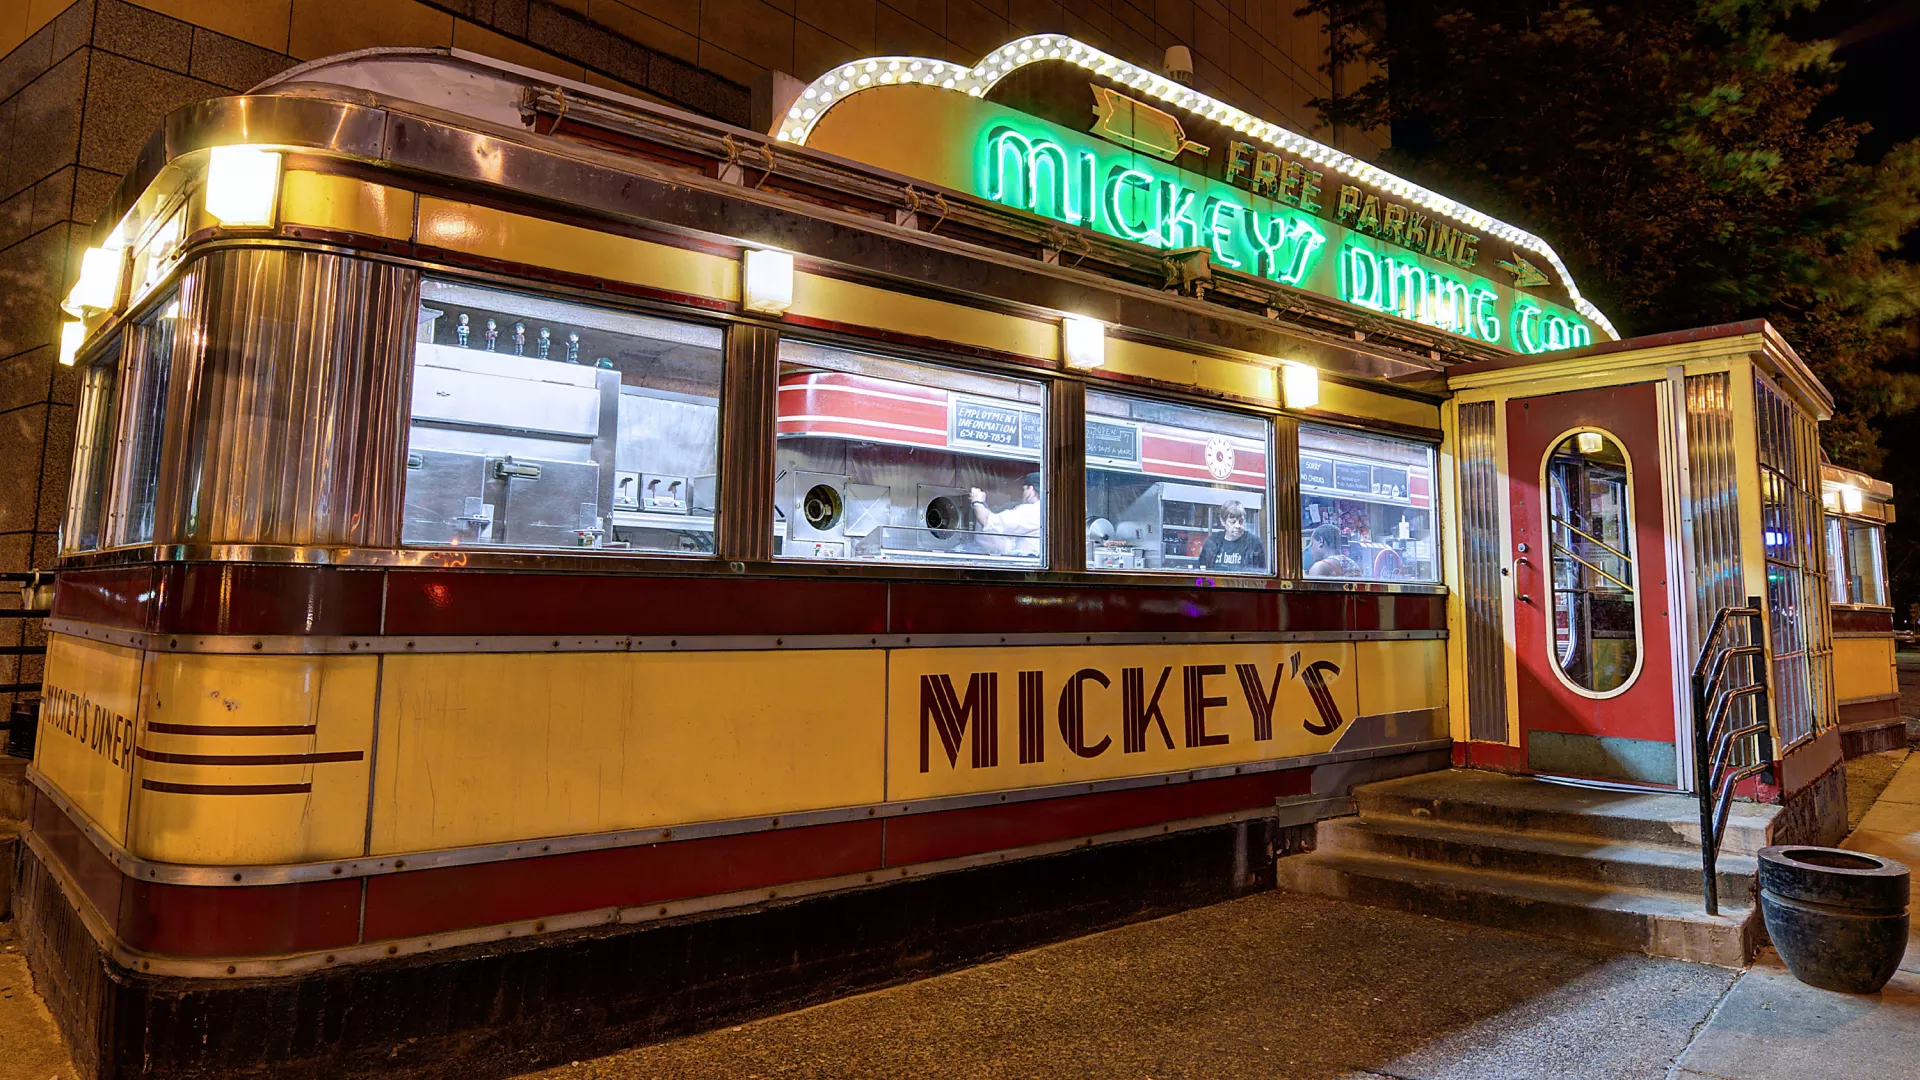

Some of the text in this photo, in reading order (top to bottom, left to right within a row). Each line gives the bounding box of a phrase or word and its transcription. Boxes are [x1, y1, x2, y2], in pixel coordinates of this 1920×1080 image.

[1225, 140, 1480, 269] FREE PARKING
[987, 125, 1327, 285] MICKEY'S
[1341, 243, 1500, 343] DINING
[958, 407, 1018, 424] EMPLOYMENT
[958, 418, 1018, 434] INFORMATION
[960, 429, 1012, 443] 651-769-7854
[1305, 461, 1322, 472] SORRY
[44, 683, 133, 773] MICKEY'S DINER
[919, 650, 1344, 774] MICKEY'S
